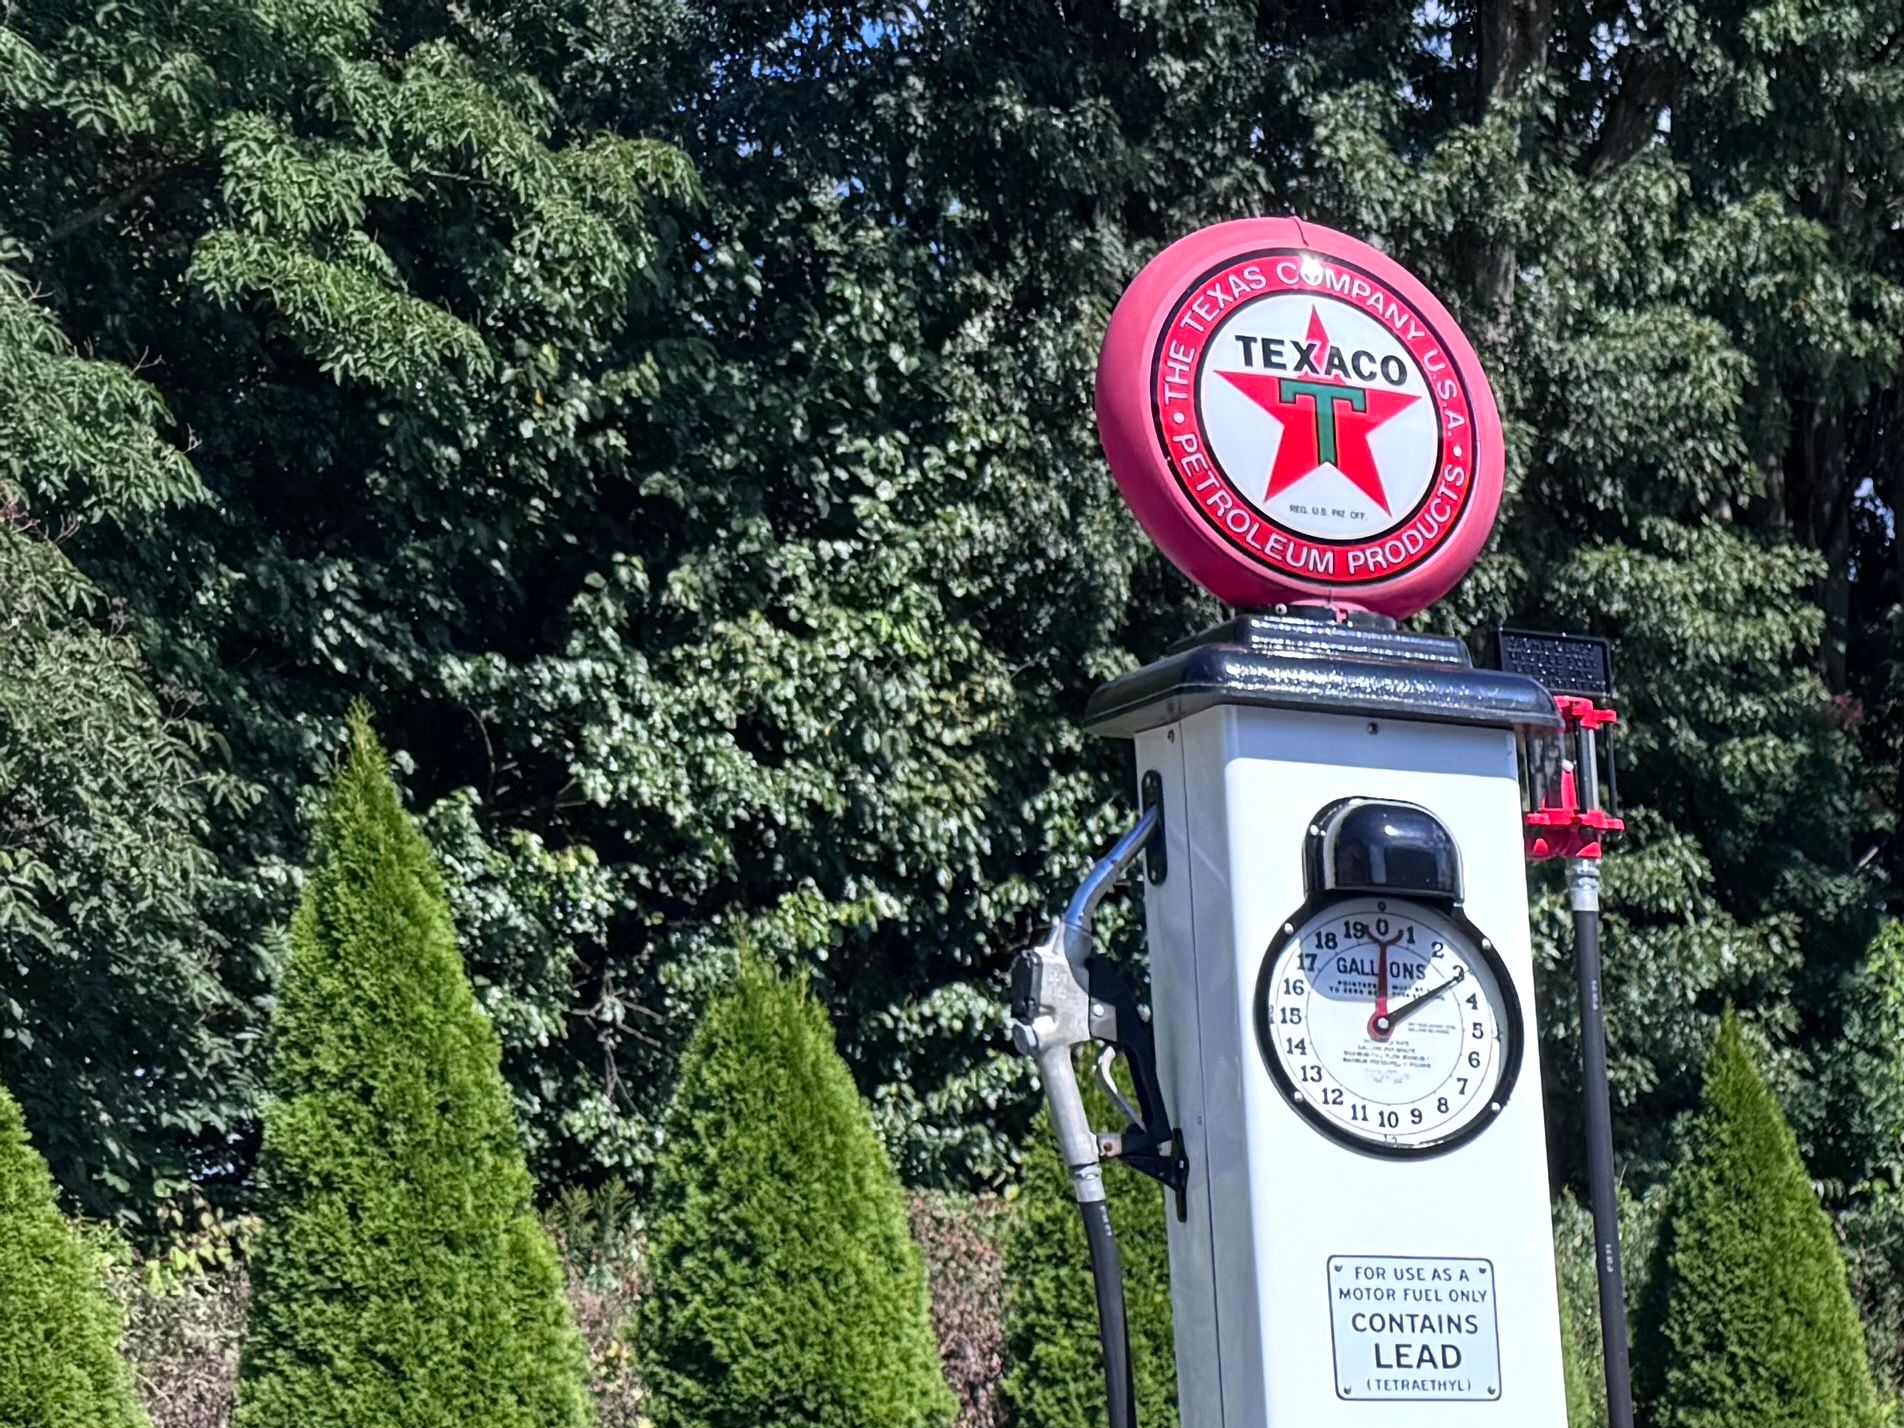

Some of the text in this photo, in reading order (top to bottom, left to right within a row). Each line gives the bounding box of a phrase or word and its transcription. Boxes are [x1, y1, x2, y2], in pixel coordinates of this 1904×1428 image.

[1164, 260, 1466, 440] THE TEXAS COMPANY U.S.A.
[1234, 333, 1409, 387] TEXACO
[1277, 377, 1368, 469] T
[1172, 432, 1466, 576] PETROLEUM PRODUCTS
[1343, 920, 1366, 940] 19
[1375, 917, 1390, 937] 0
[1406, 925, 1416, 945] 1
[1314, 930, 1338, 951] 18
[1431, 940, 1445, 959] 2
[1296, 952, 1318, 973] 17
[1335, 956, 1427, 981] GALLONS
[1283, 977, 1306, 997] 16
[1465, 992, 1479, 1011] 4
[1279, 1006, 1303, 1025] 15
[1471, 1021, 1485, 1040] 5
[1285, 1036, 1308, 1056] 14
[1467, 1050, 1482, 1069] 6
[1299, 1065, 1324, 1083] 13
[1455, 1076, 1469, 1096] 7
[1321, 1087, 1345, 1106] 12
[1436, 1095, 1450, 1115] 8
[1350, 1104, 1370, 1122] 11
[1377, 1110, 1400, 1129] 10
[1409, 1107, 1424, 1125] 9
[1354, 1265, 1470, 1282] FOR USE AS A
[1338, 1287, 1488, 1303] MOTOR FUEL ONLY
[1350, 1312, 1479, 1335] CONTAINS
[1374, 1342, 1463, 1370] LEAD
[1366, 1378, 1472, 1393] (TETRAETHYL)
